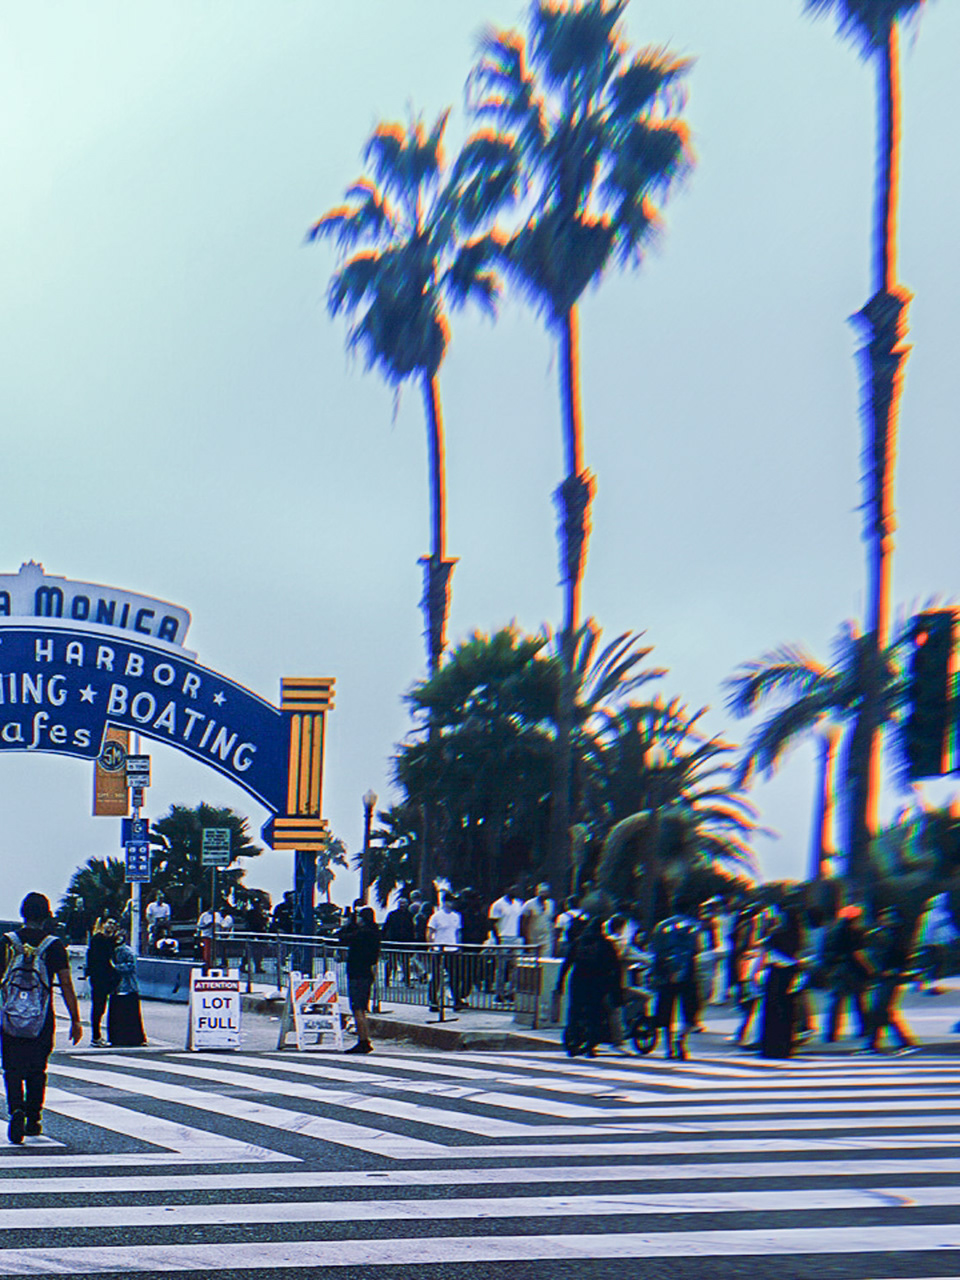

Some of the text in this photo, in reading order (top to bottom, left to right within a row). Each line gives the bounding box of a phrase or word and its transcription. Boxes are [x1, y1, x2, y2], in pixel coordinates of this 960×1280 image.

[34, 585, 180, 643] MONICA
[35, 639, 202, 698] HARBOR
[108, 683, 257, 772] BOATING
[194, 981, 238, 991] ATTENTION
[202, 997, 232, 1009] LOT
[198, 1017, 237, 1029] FULL
